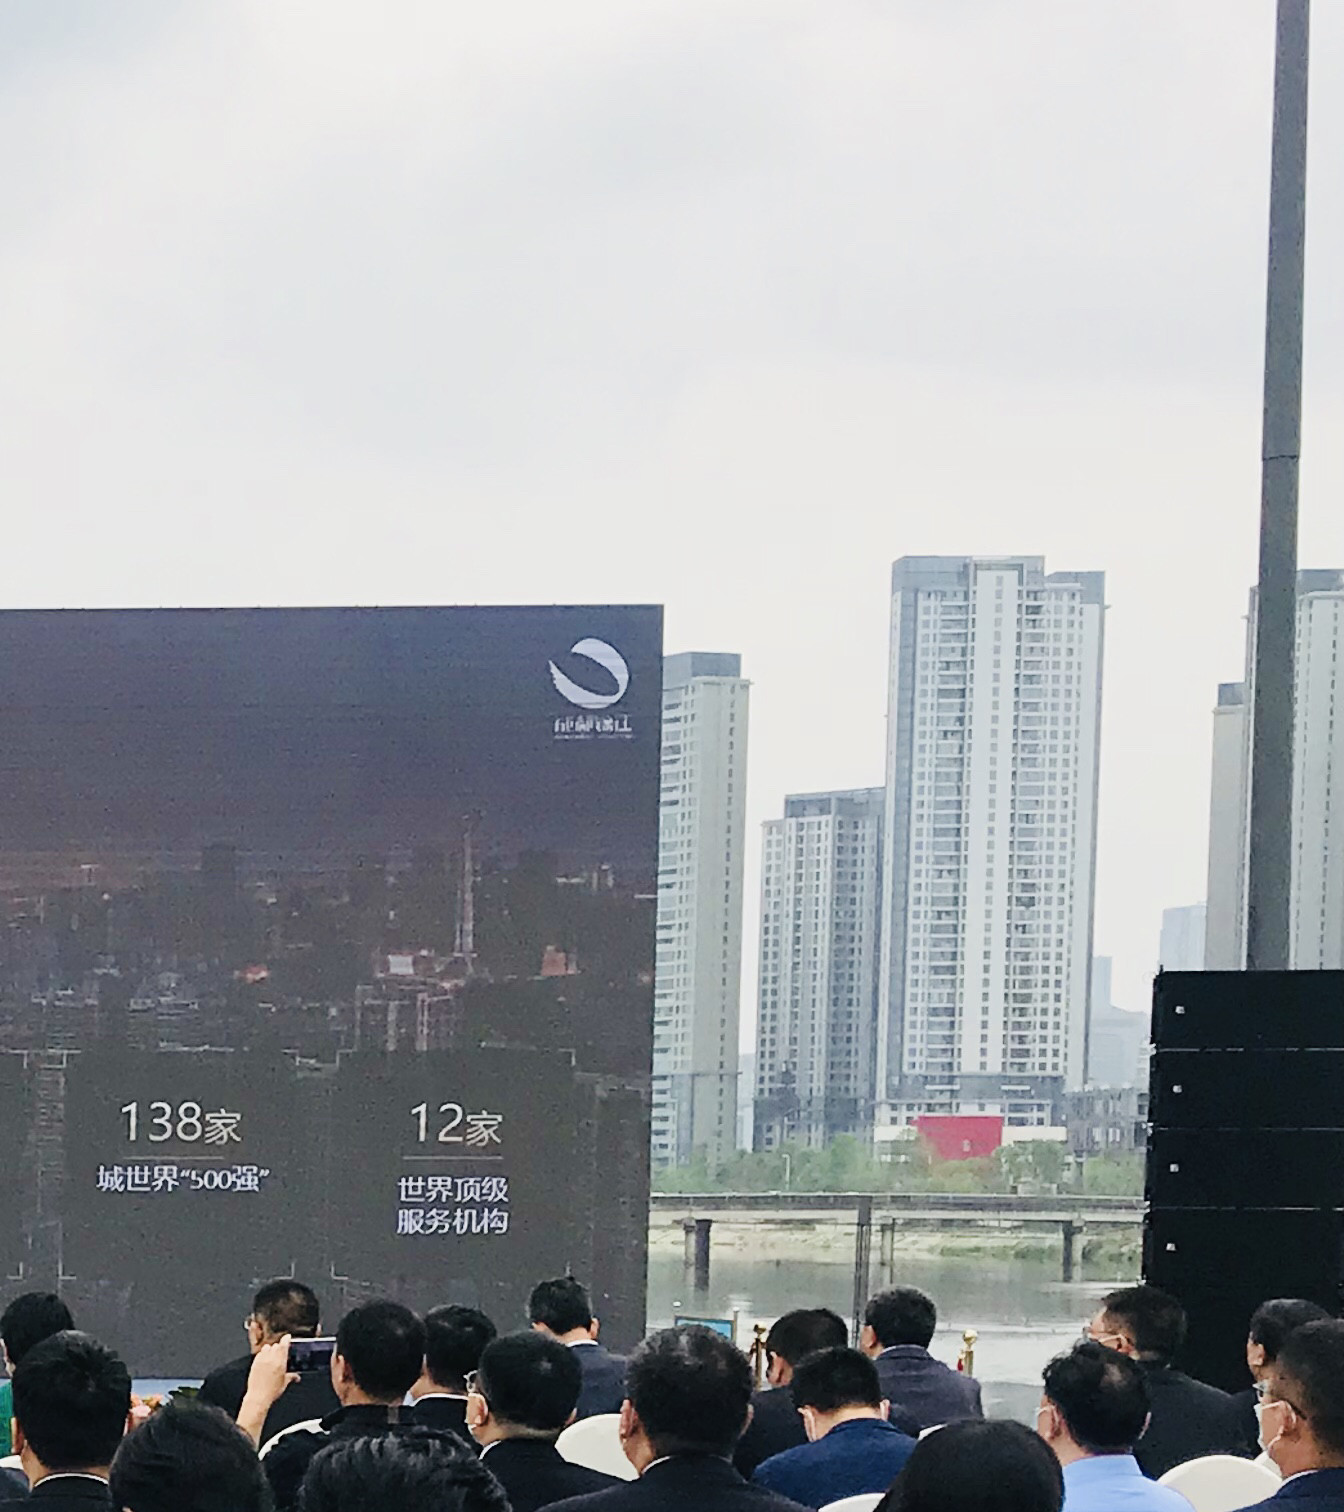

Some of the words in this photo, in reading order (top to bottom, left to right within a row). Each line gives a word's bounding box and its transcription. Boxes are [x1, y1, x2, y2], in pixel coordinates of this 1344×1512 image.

[121, 1102, 243, 1147] 138家
[412, 1102, 504, 1148] 12家
[398, 1176, 510, 1204] 世界顶级
[397, 1208, 510, 1236] 服务机构
